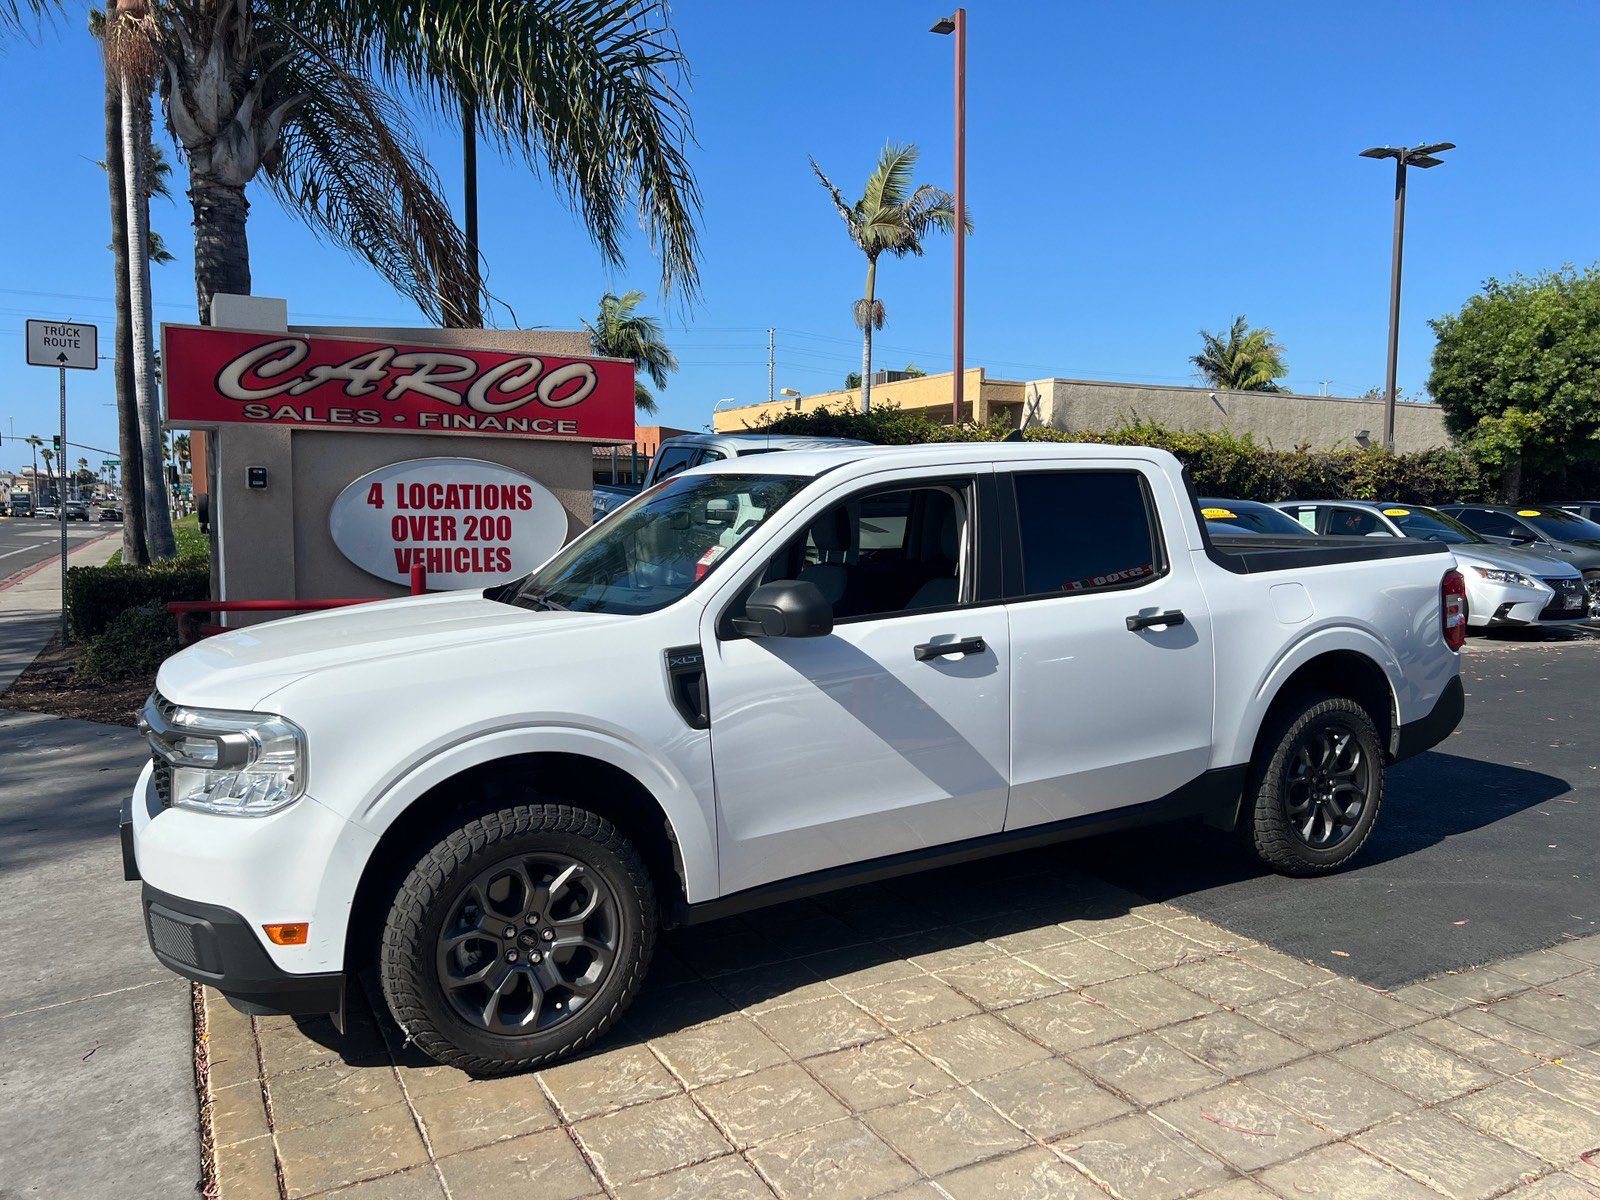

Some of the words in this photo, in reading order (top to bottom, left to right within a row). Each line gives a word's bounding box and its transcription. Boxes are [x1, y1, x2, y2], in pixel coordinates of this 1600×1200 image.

[43, 325, 81, 338] TRUCK
[43, 337, 81, 349] ROUTE
[214, 337, 598, 413] CARCO
[243, 404, 381, 425] SALES
[417, 411, 579, 435] FINANCE
[367, 482, 384, 509] 4
[396, 483, 533, 511] LOCATIONS
[391, 515, 457, 541] OVER
[463, 515, 512, 541] 200
[394, 547, 512, 574] VEHICLES
[670, 654, 702, 666] XLT
